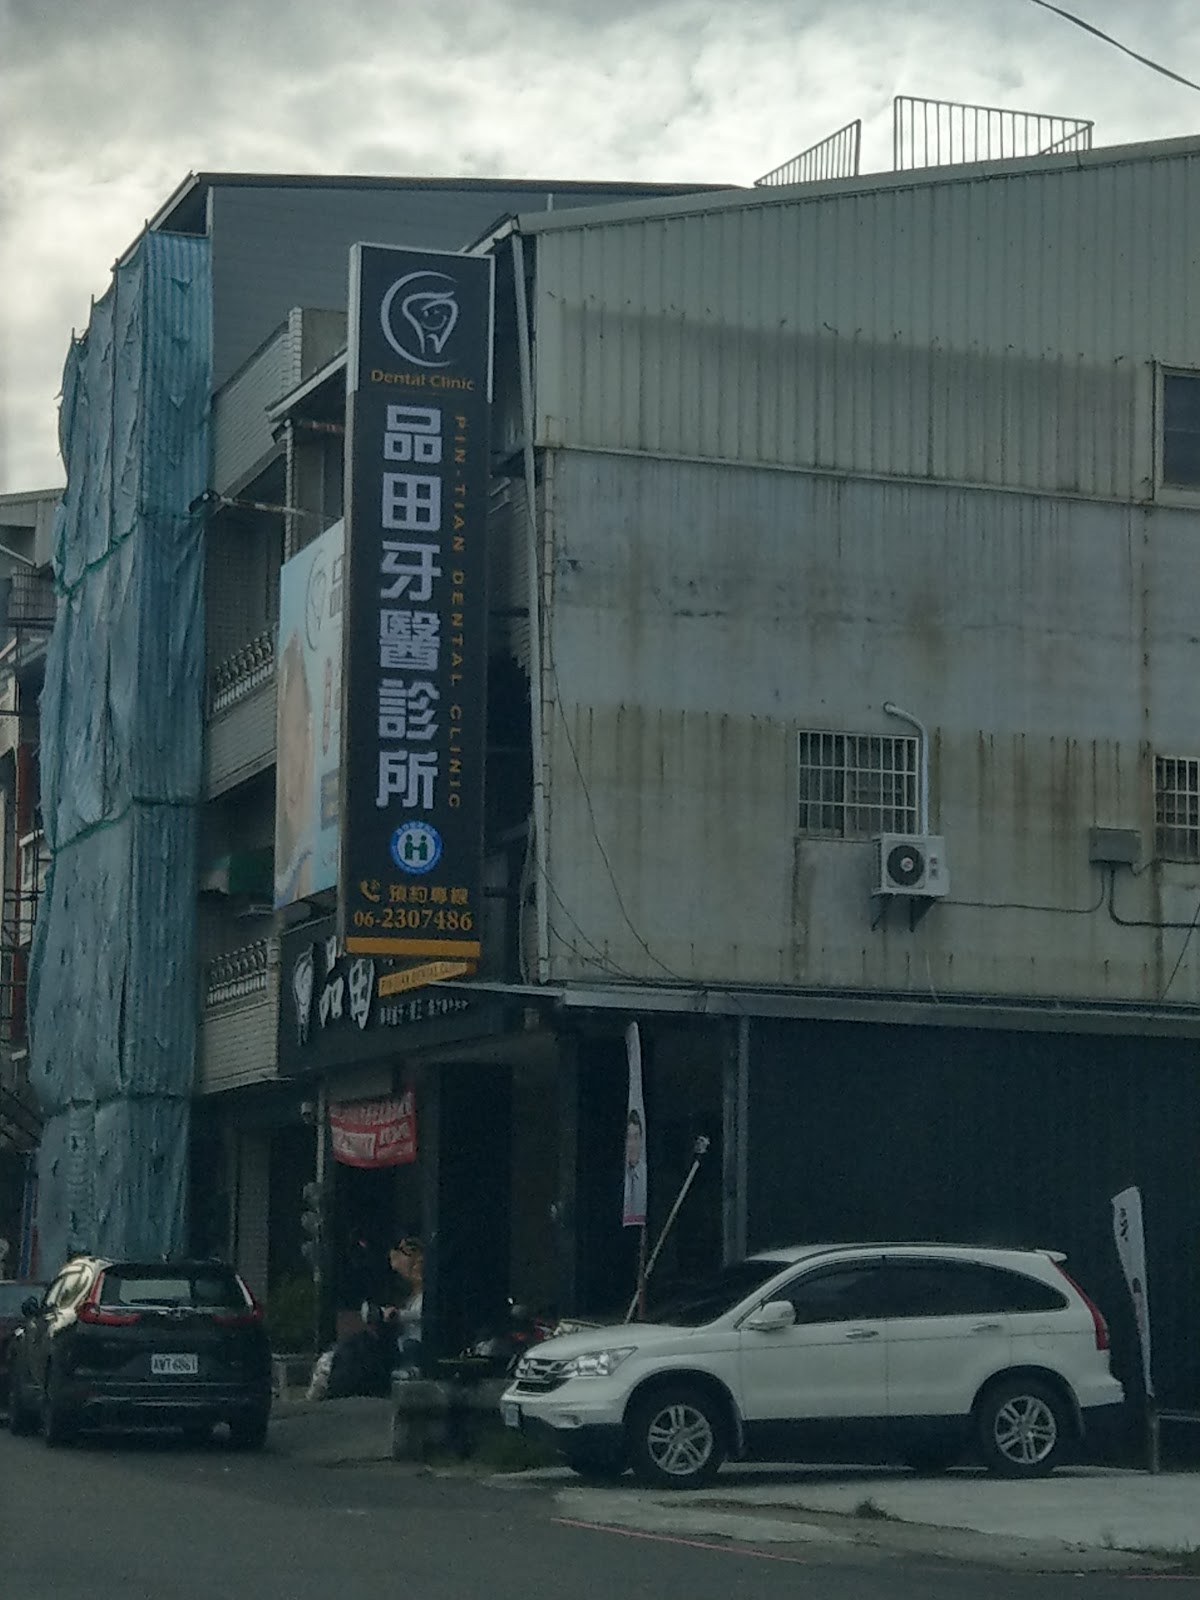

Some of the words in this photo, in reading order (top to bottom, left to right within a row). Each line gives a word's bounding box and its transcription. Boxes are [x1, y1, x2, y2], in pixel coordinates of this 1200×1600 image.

[371, 369, 426, 388] Dental
[429, 373, 475, 391] Clinic
[376, 404, 443, 810] 品田牙醫診所
[450, 569, 465, 687] DENTAL
[448, 705, 463, 809] CLINIC
[353, 908, 473, 931] 06-2307486
